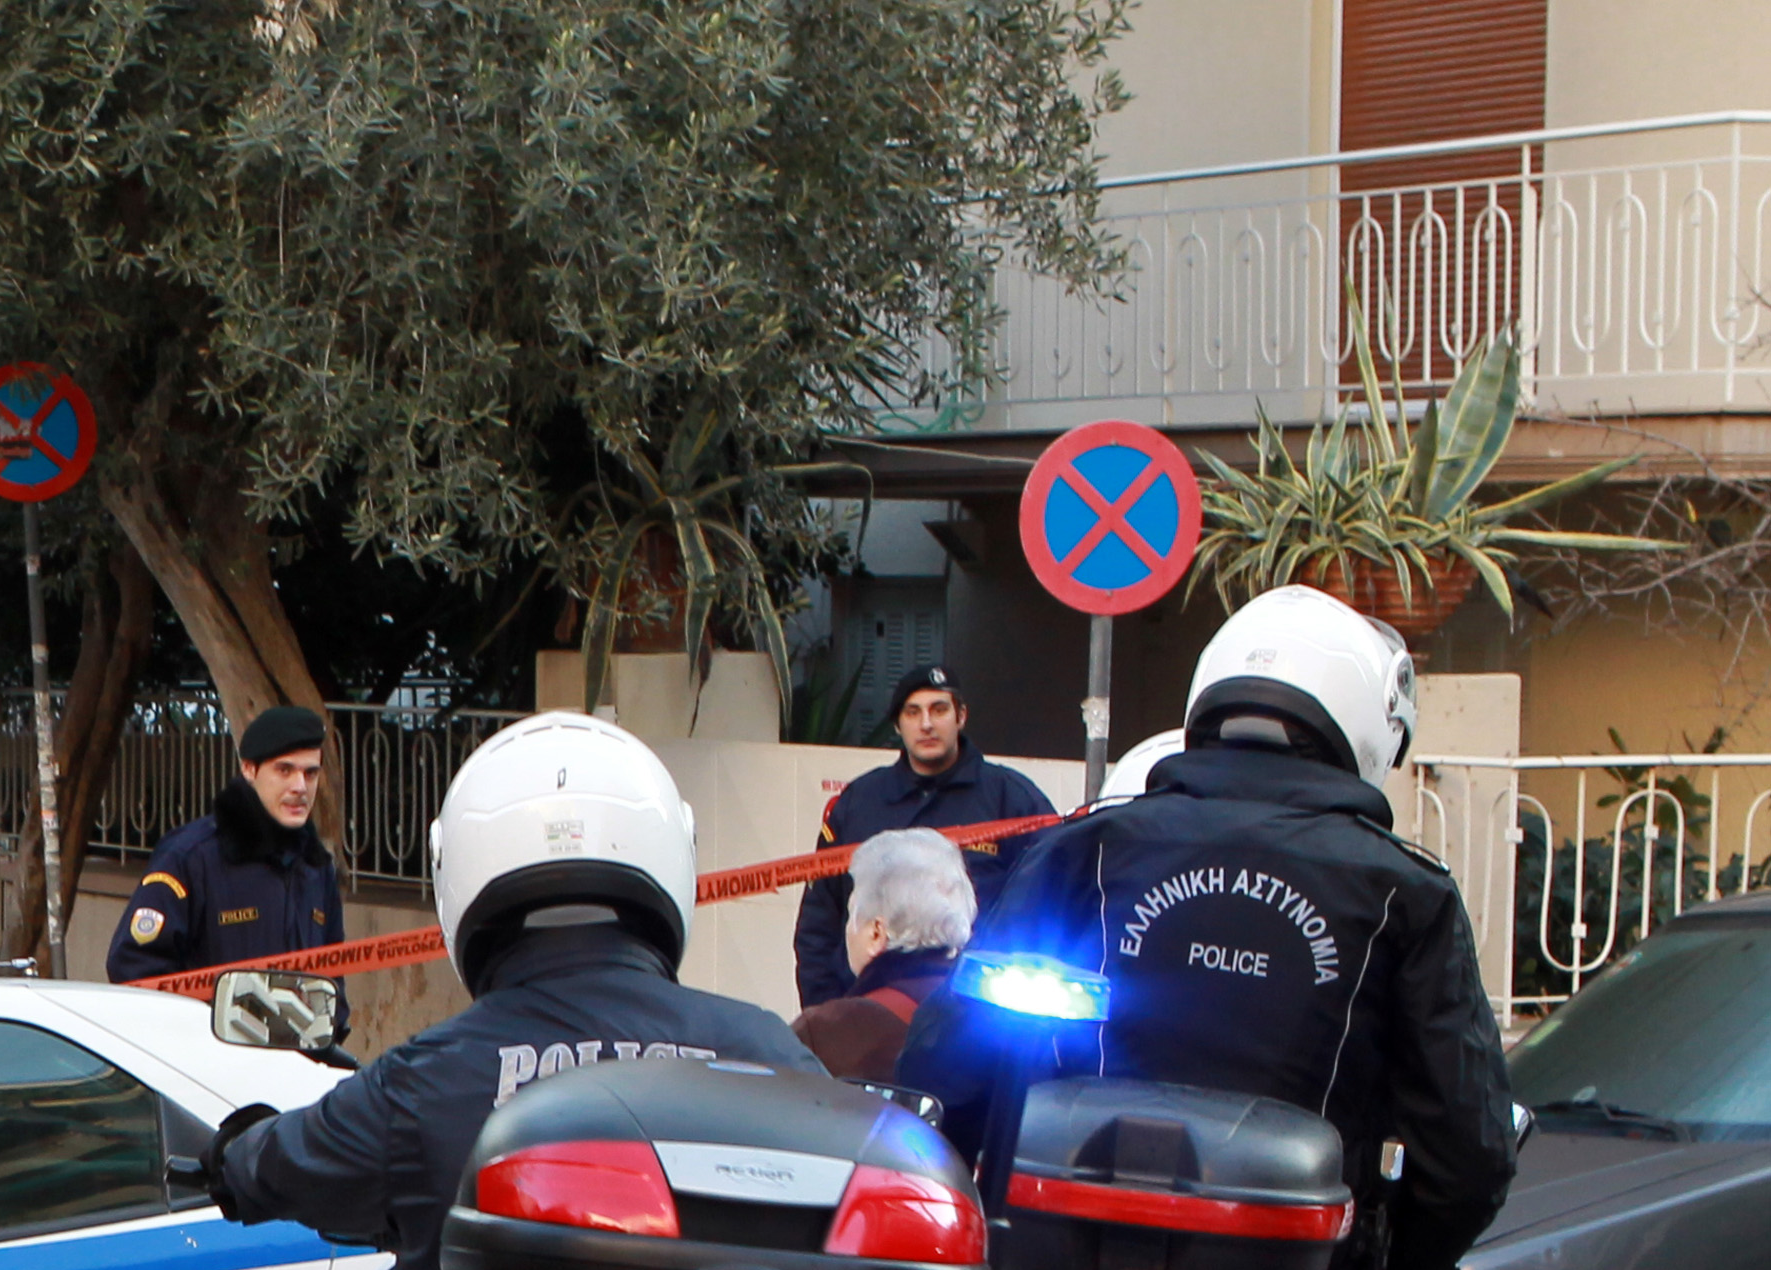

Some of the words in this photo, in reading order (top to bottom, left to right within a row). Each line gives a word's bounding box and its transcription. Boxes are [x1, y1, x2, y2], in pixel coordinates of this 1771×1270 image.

[221, 908, 256, 923] POLICE
[1119, 866, 1225, 958] ΕΛΛΗΝΙΚΗ
[1230, 868, 1340, 986] ΑΣΤΥΝΟΜΙΑ
[1188, 942, 1270, 978] POLICE
